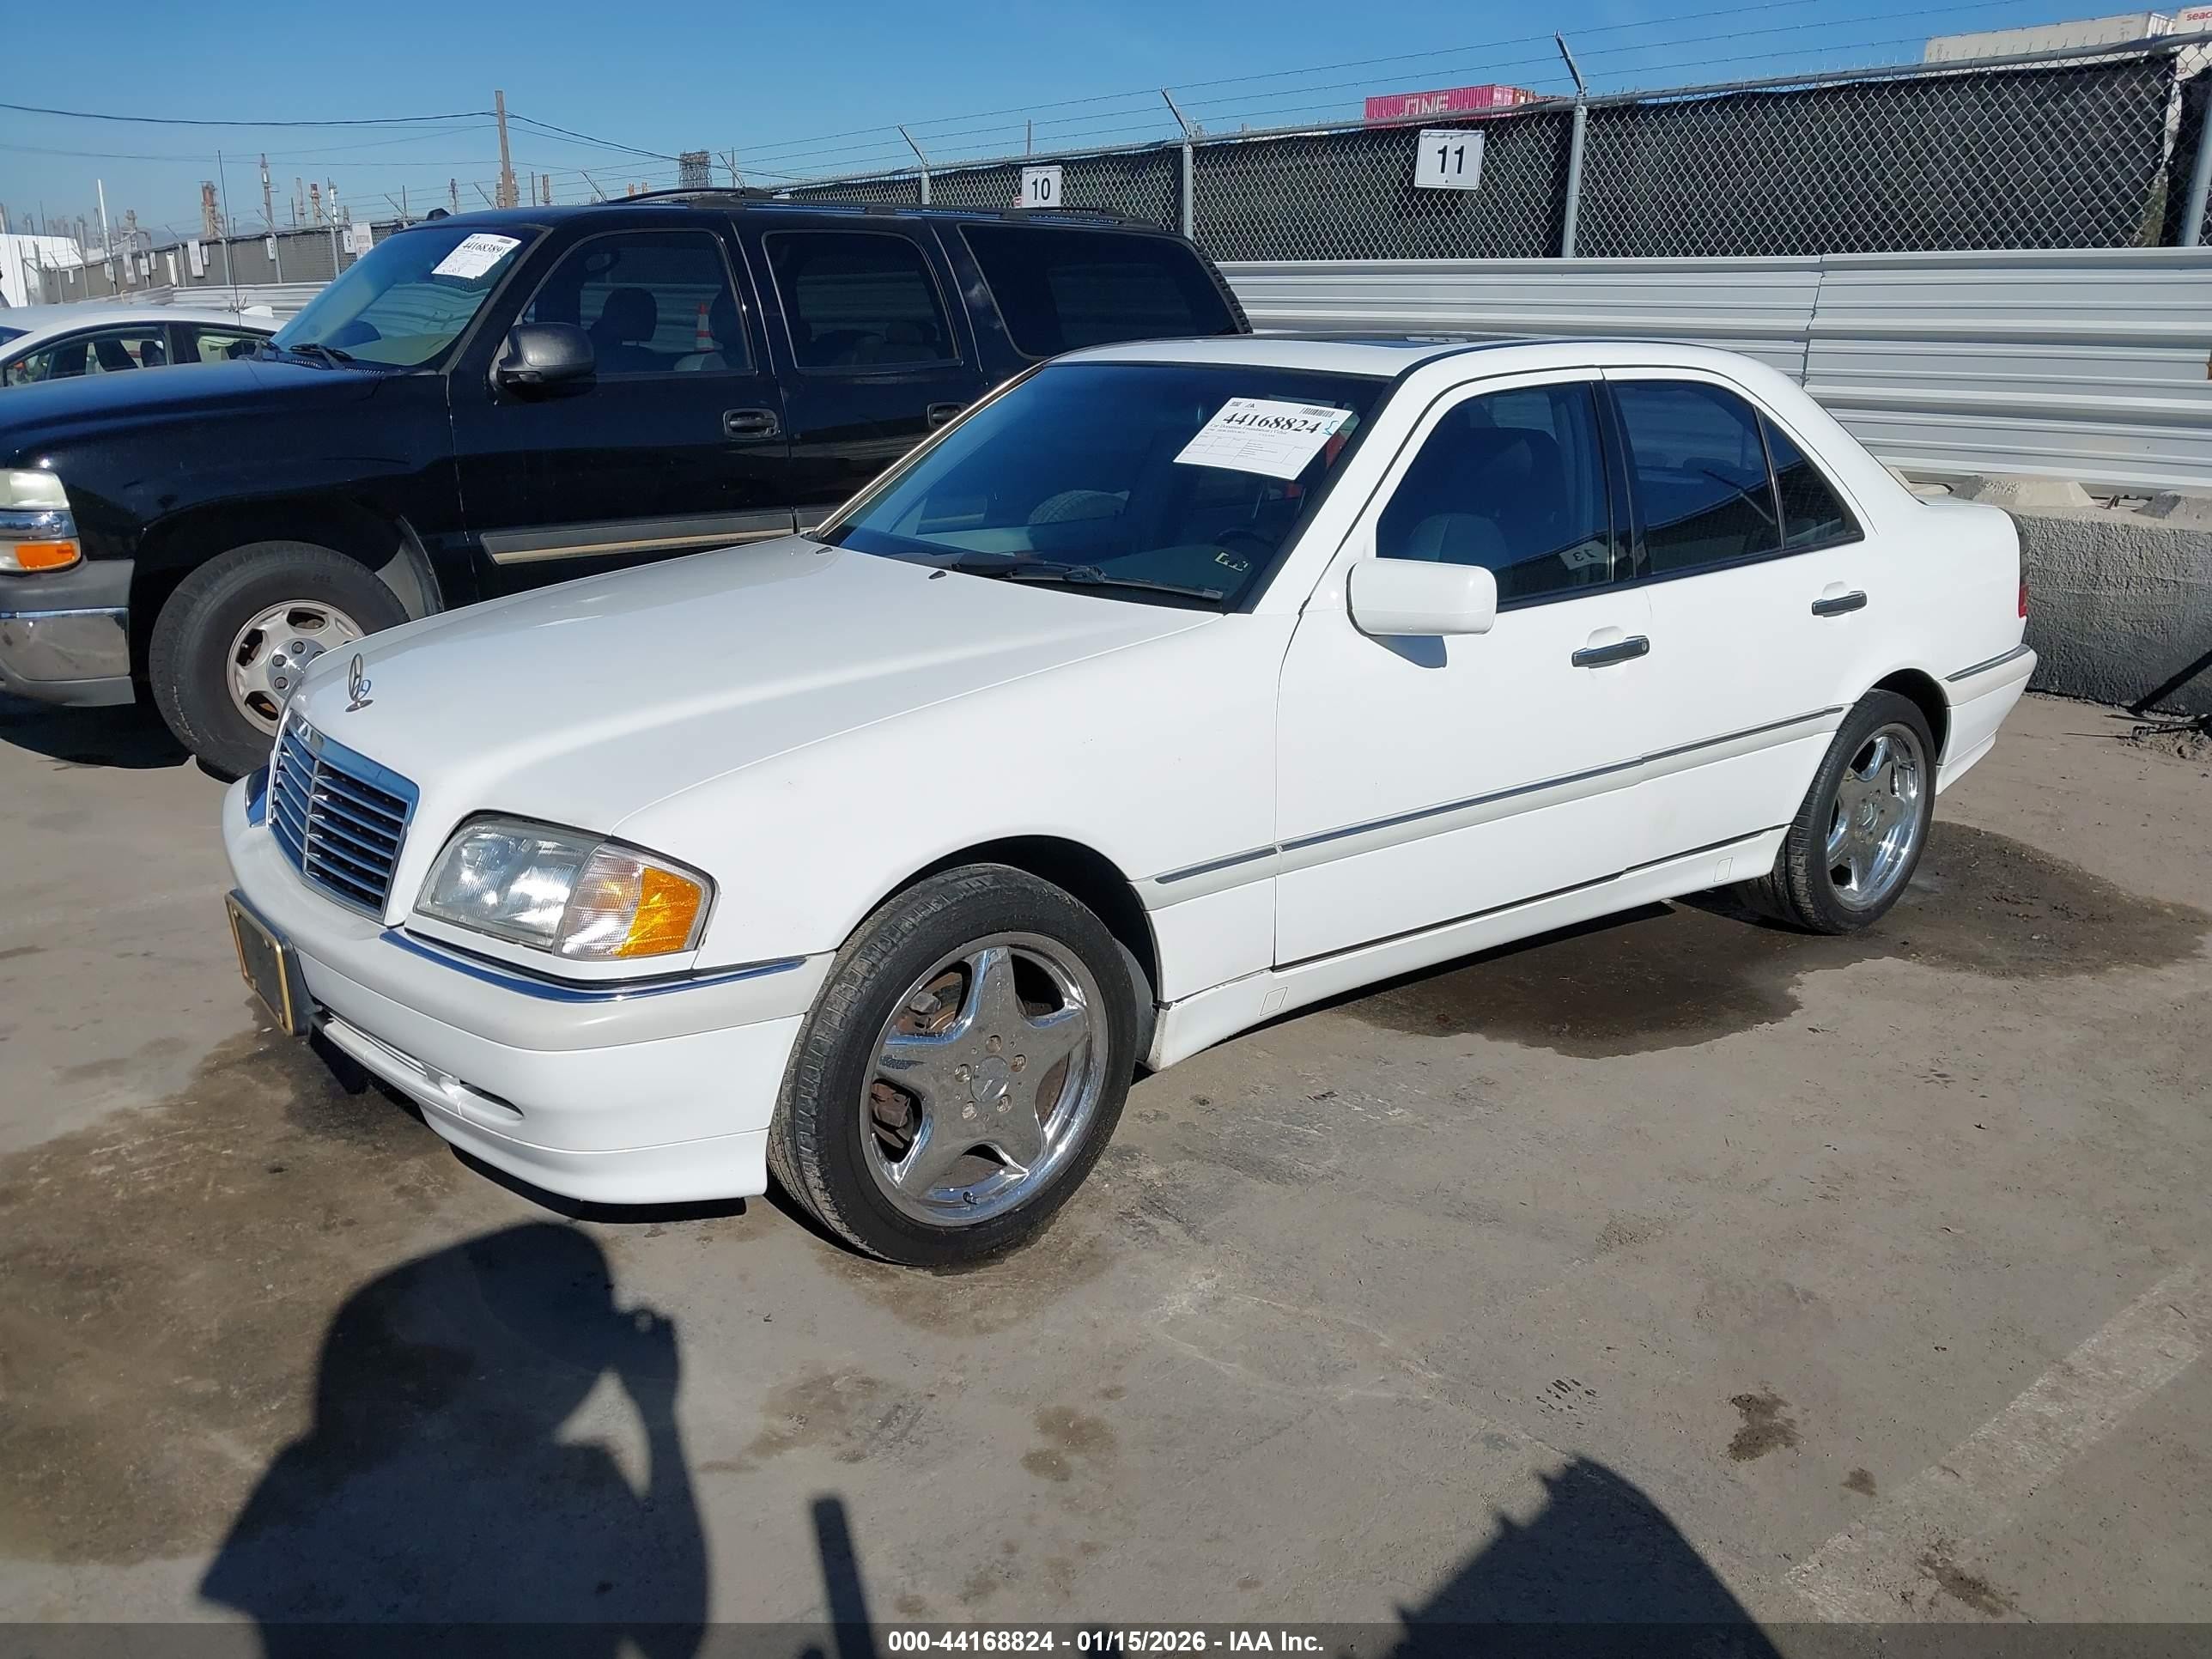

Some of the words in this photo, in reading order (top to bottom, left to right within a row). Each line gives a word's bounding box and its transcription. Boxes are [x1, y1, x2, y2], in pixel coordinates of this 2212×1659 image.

[1405, 94, 1449, 115] ONE
[1437, 144, 1465, 174] 11
[1031, 177, 1051, 201] 10
[1223, 412, 1322, 434] 44168824
